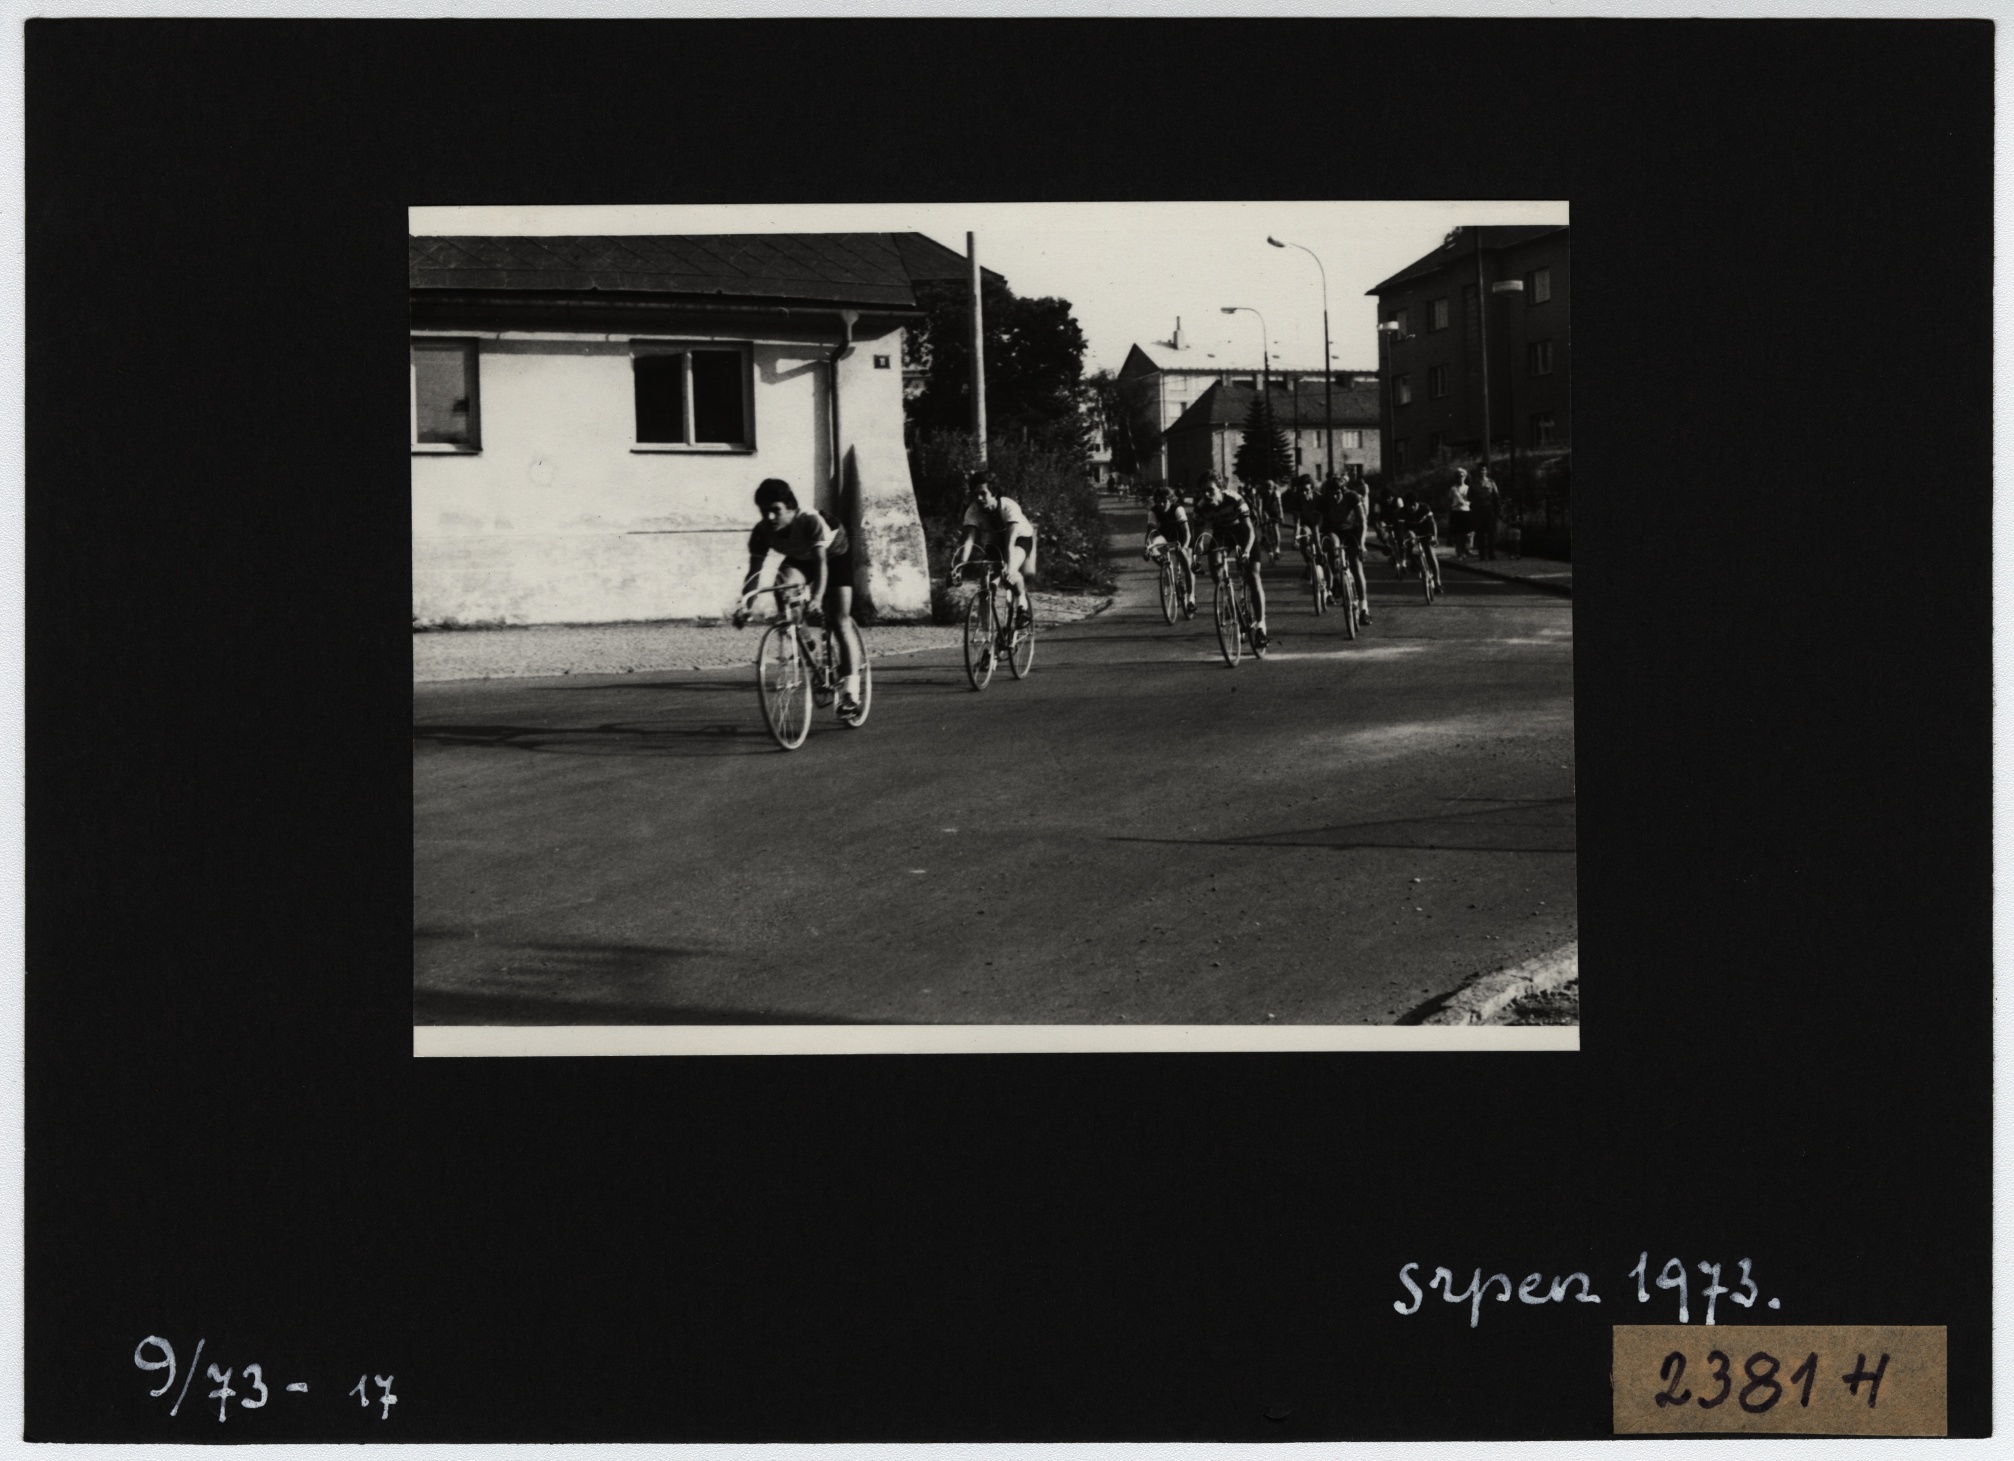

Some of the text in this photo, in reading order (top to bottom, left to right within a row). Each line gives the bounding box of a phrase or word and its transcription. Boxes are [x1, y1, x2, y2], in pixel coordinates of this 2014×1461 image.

[1628, 1251, 1781, 1325] 1973.
[349, 1374, 398, 1420] 17
[1653, 1349, 1892, 1415] 2381 H
